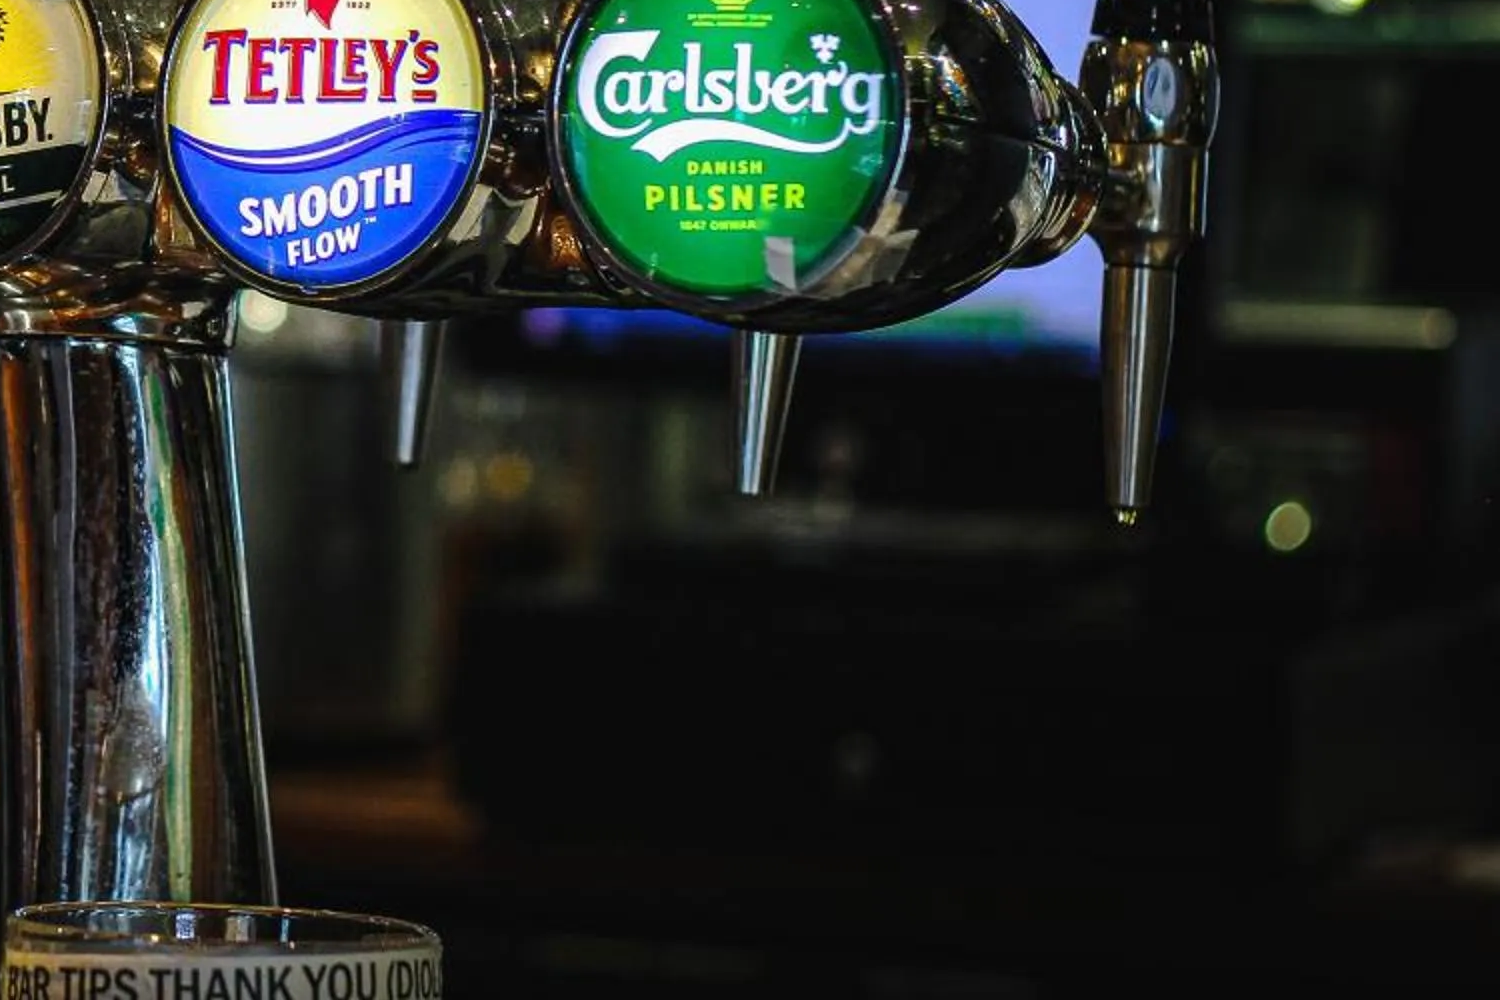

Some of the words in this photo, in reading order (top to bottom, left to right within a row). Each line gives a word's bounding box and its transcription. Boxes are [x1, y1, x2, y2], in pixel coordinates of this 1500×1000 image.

[203, 28, 440, 105] TETLEY'S
[577, 29, 885, 138] Carlsberg
[686, 160, 763, 175] DANISH
[239, 163, 414, 238] SMOOTH
[644, 183, 805, 211] PILSNER
[6, 964, 50, 1000] BAR
[57, 966, 138, 1000] TIPS
[148, 964, 294, 1000] THANK
[302, 961, 377, 1000] YOU
